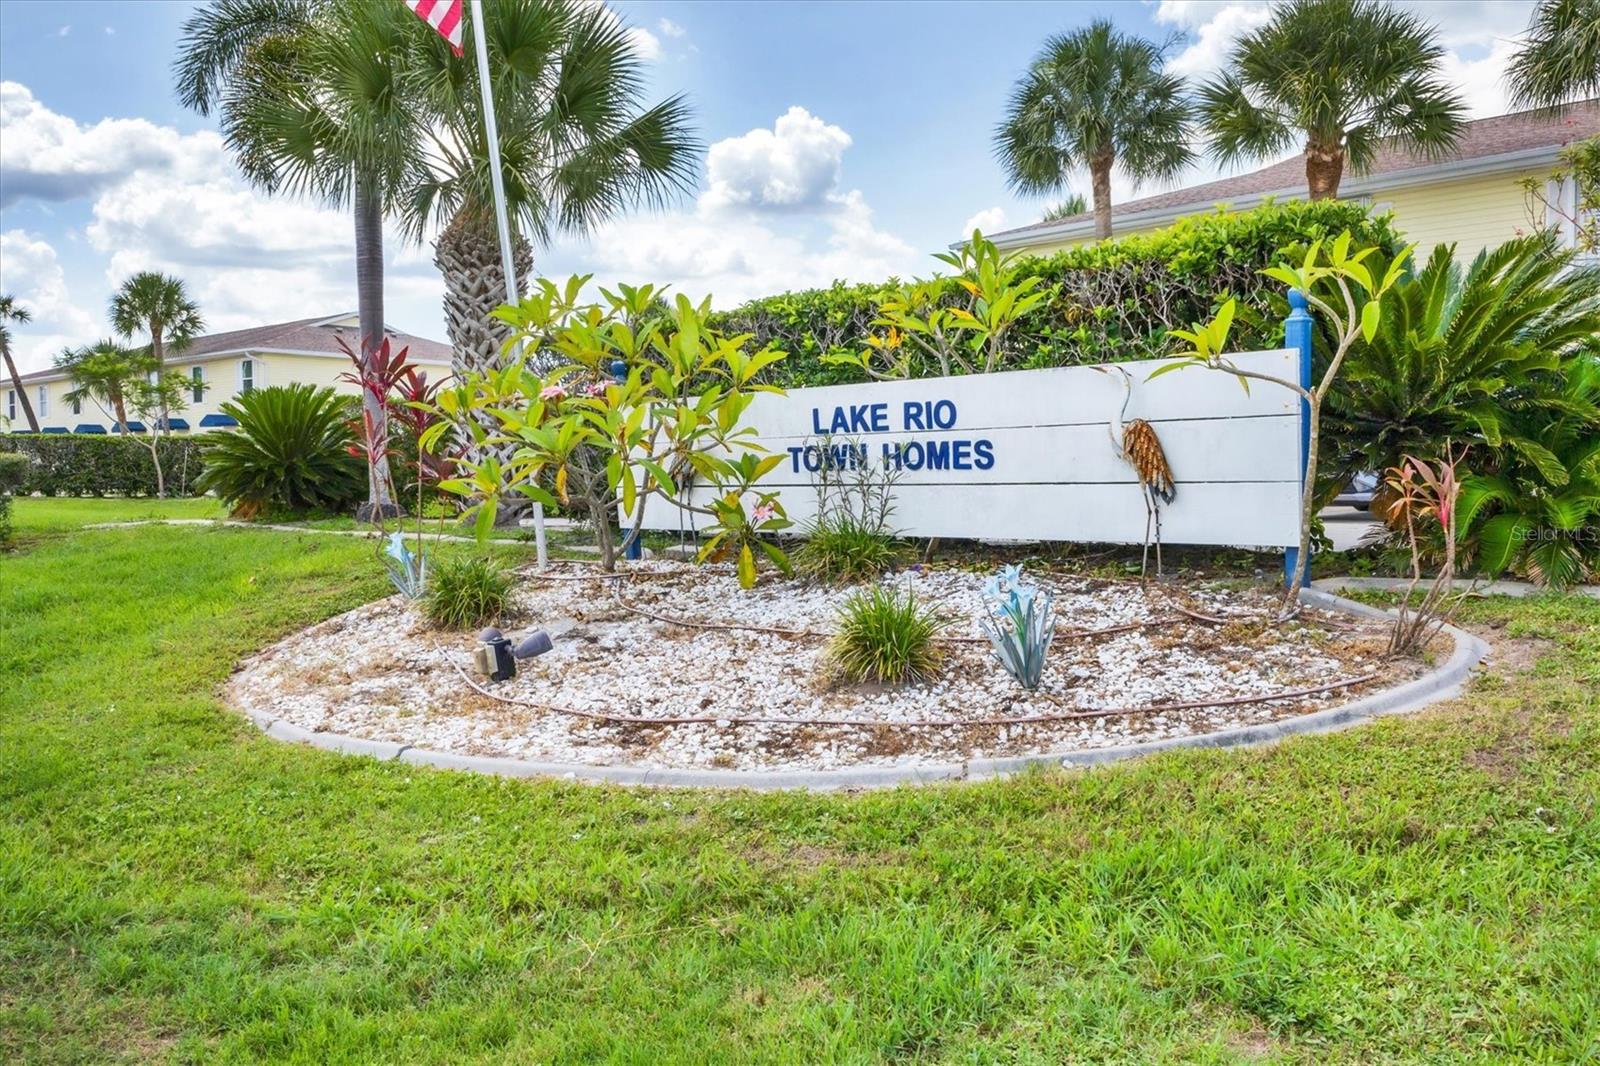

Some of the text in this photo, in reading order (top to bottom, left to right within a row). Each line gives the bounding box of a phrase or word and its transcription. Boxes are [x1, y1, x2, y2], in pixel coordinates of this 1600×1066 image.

[812, 399, 958, 435] LAKE RIO
[787, 439, 995, 473] TOWN HOMES
